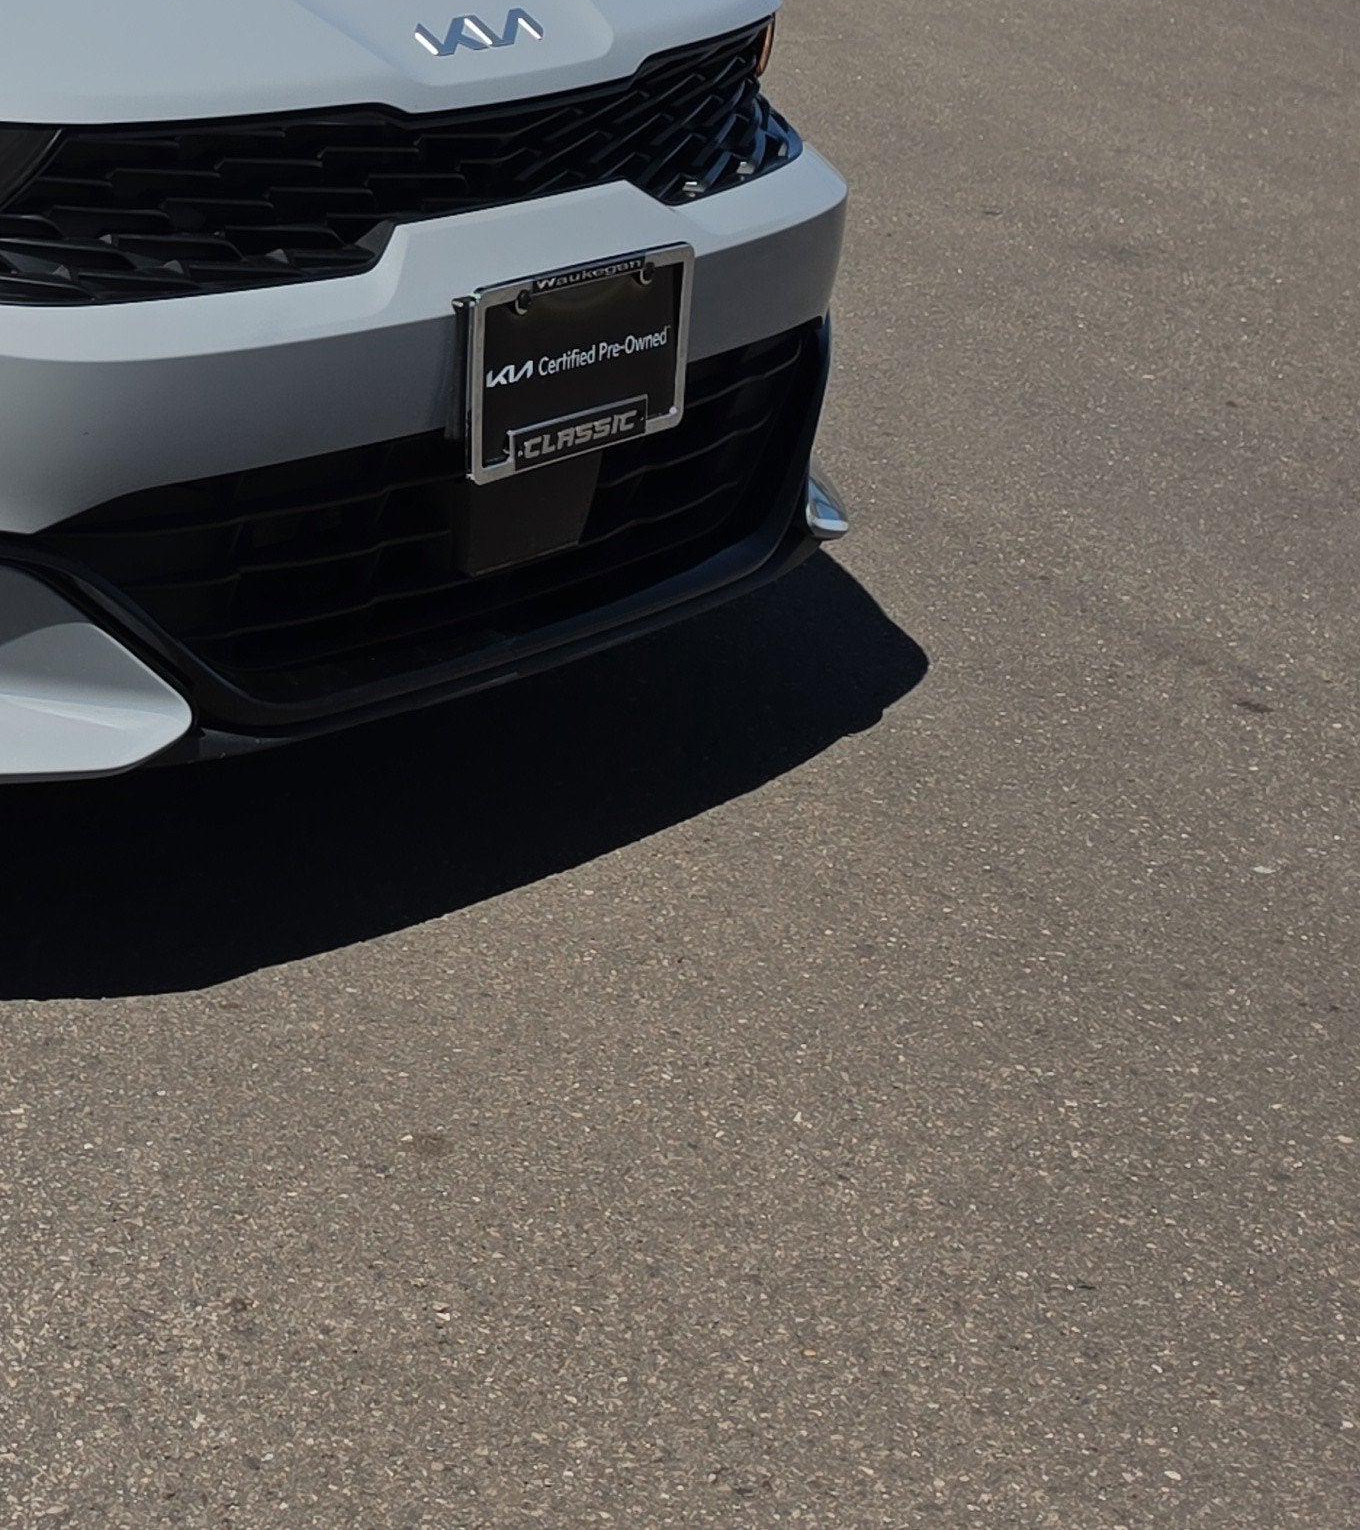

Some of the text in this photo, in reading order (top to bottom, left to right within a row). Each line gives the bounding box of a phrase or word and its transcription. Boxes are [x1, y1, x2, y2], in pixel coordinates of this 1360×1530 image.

[414, 7, 544, 57] KIA
[536, 259, 643, 290] Waukegan
[485, 326, 669, 388] KIA Certified Pre-Owned
[523, 409, 638, 459] CLASSIC
